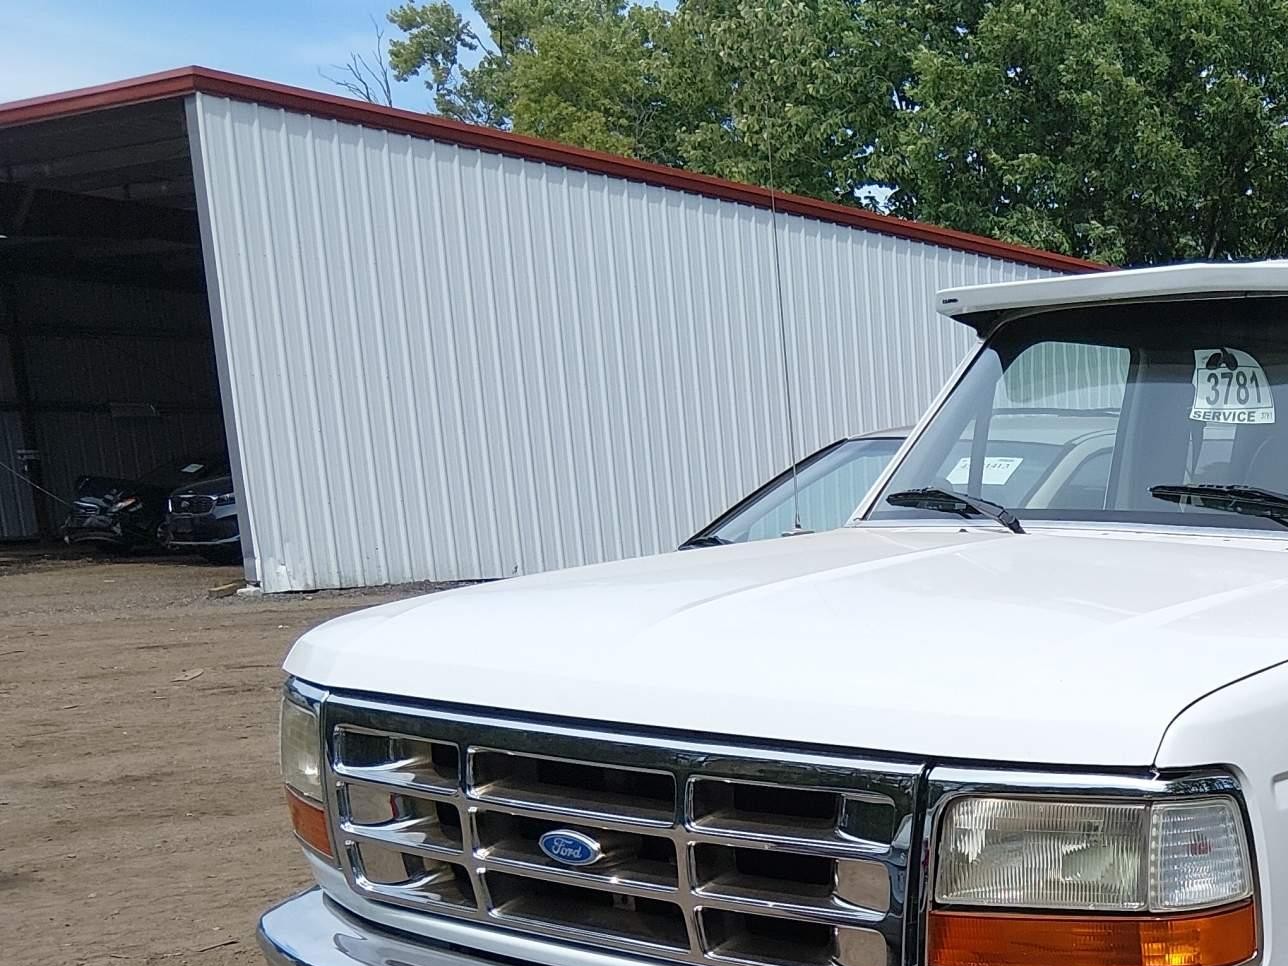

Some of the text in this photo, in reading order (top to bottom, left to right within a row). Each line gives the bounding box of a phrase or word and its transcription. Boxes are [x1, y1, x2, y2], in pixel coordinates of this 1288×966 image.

[1206, 371, 1261, 405] 3781
[1192, 410, 1256, 422] SERVICE
[552, 838, 582, 858] Ford
